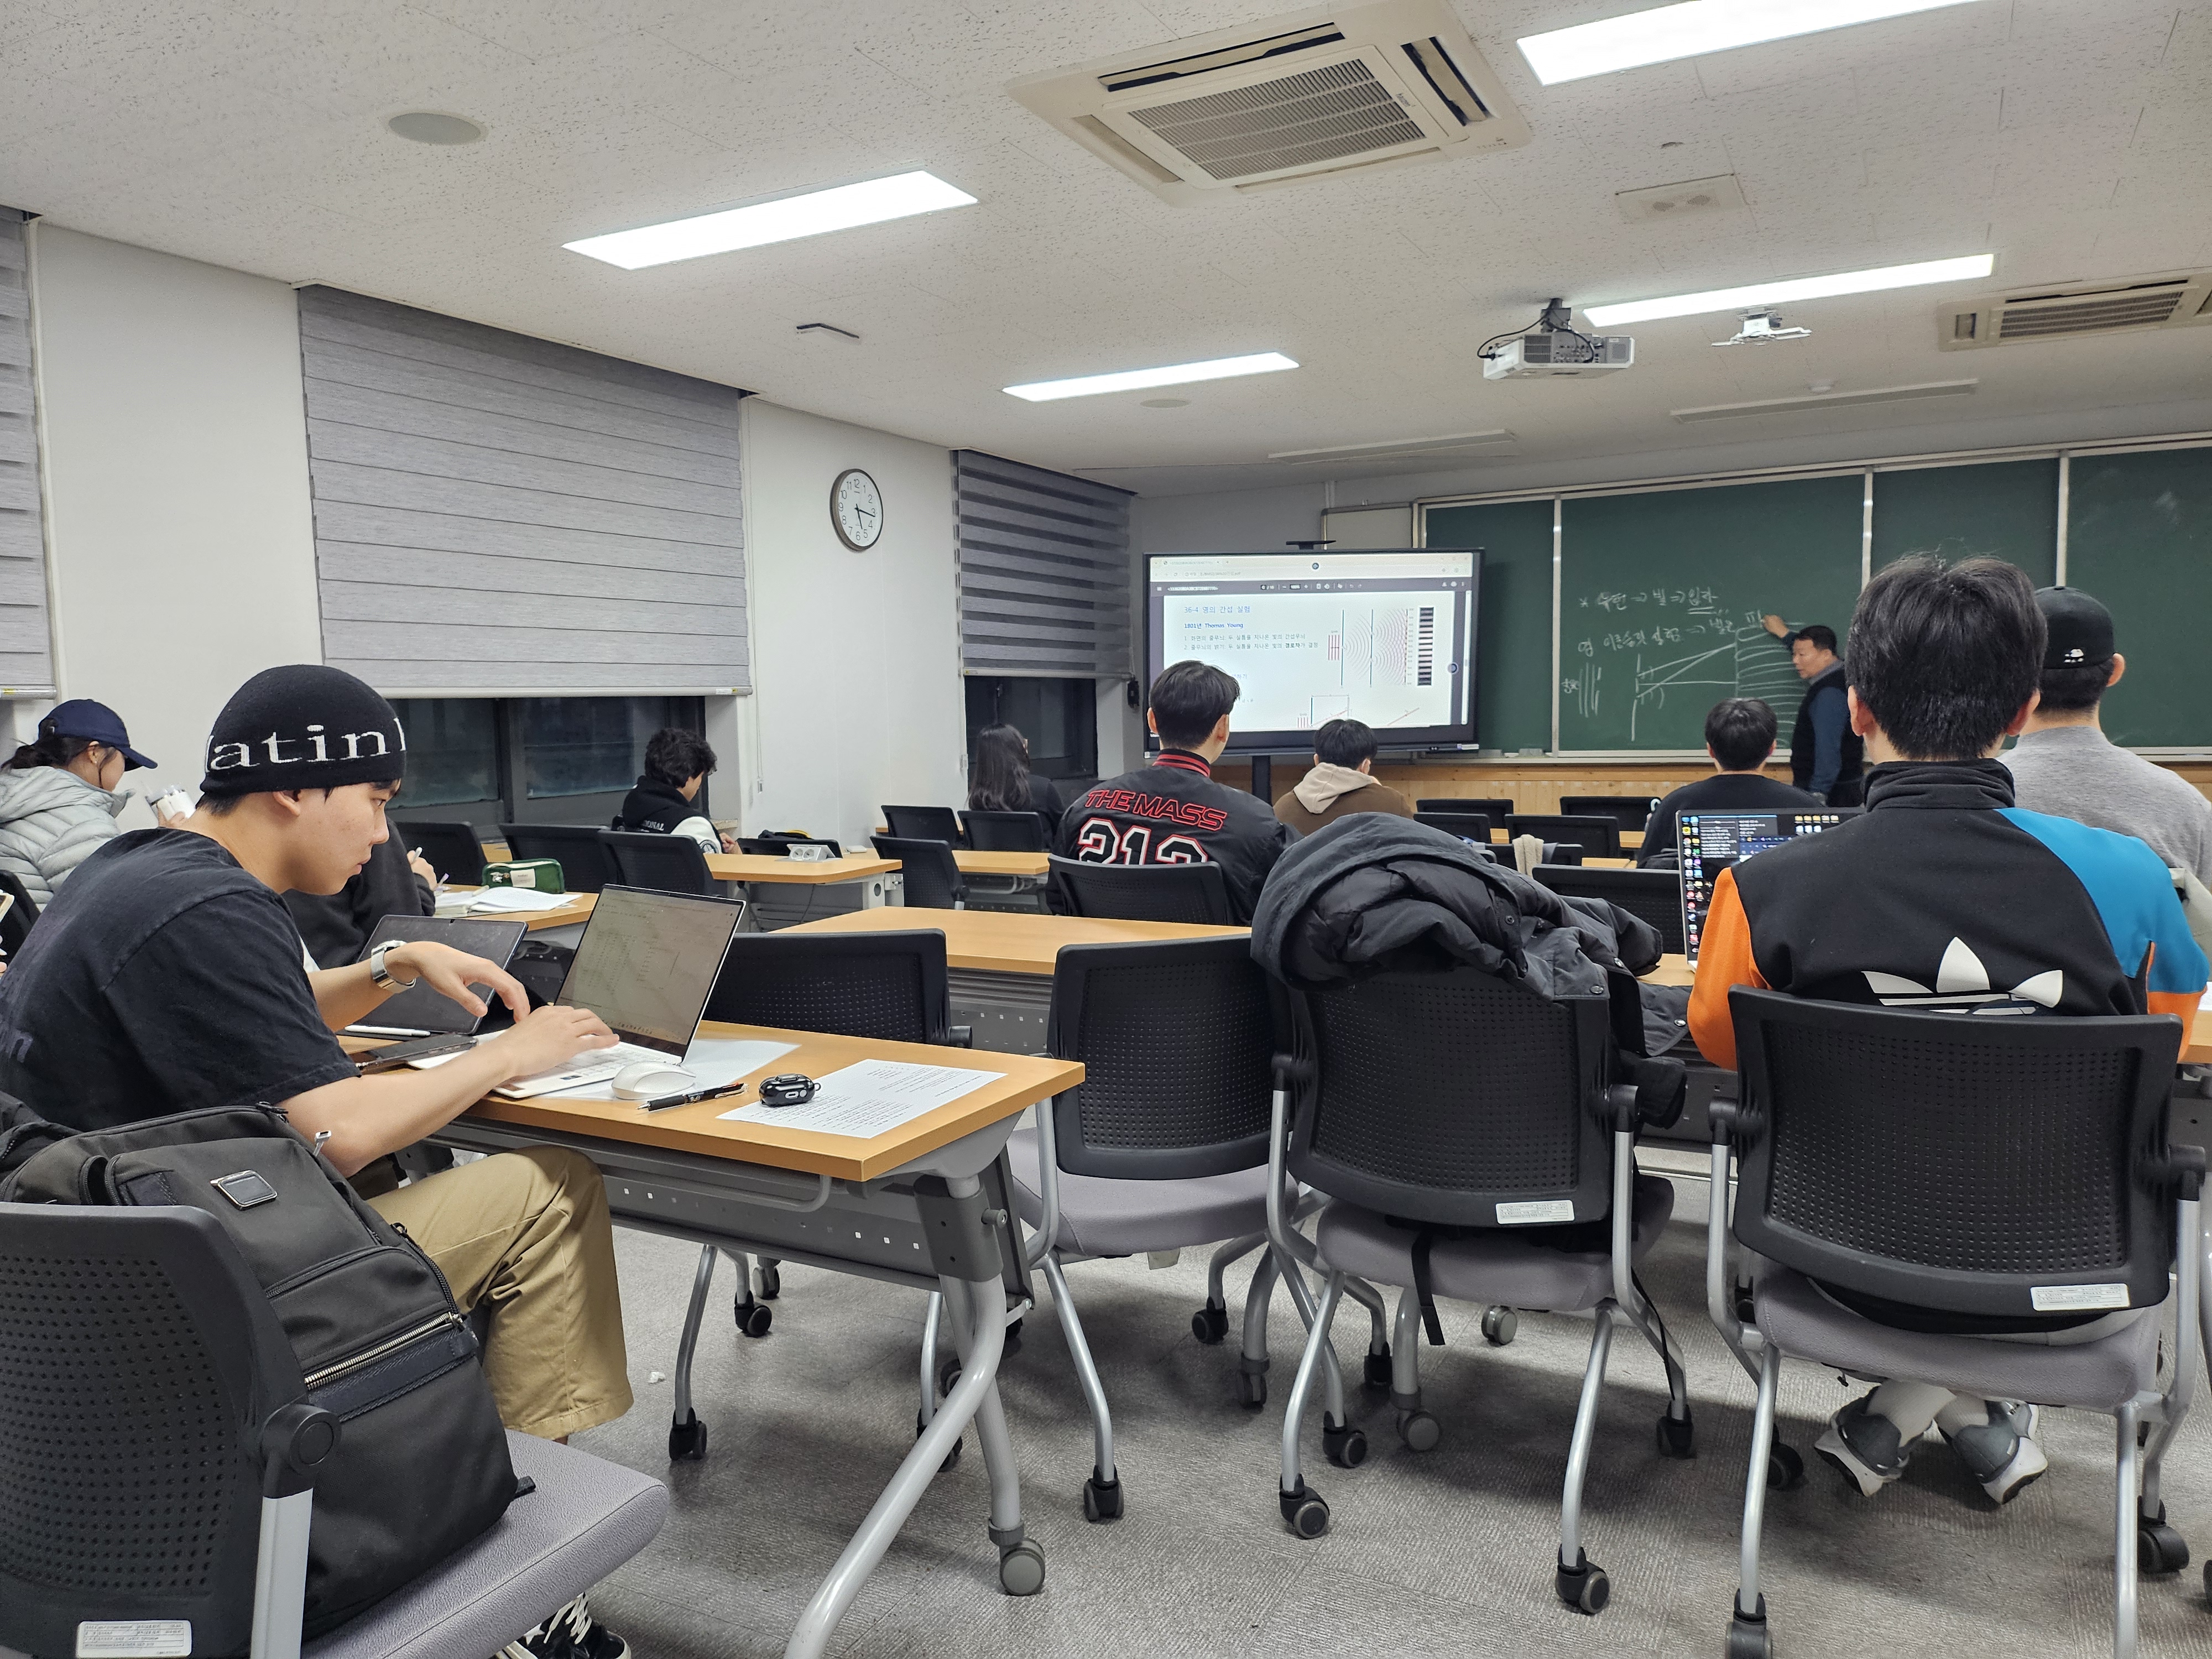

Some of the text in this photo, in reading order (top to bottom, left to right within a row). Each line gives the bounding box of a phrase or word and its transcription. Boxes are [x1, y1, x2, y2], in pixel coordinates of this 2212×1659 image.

[847, 481, 852, 490] 11
[853, 479, 860, 489] 12
[863, 485, 866, 493] 1
[841, 490, 847, 499] 10
[868, 494, 873, 504] 2
[838, 502, 843, 512] 9
[872, 508, 876, 517] 3
[842, 515, 847, 525] 8
[868, 520, 873, 529] 4
[848, 526, 853, 535] 7
[863, 529, 868, 538] 5
[856, 531, 860, 540] 6
[1220, 606, 1233, 614] 간섭
[1084, 789, 1228, 831] THE MASS
